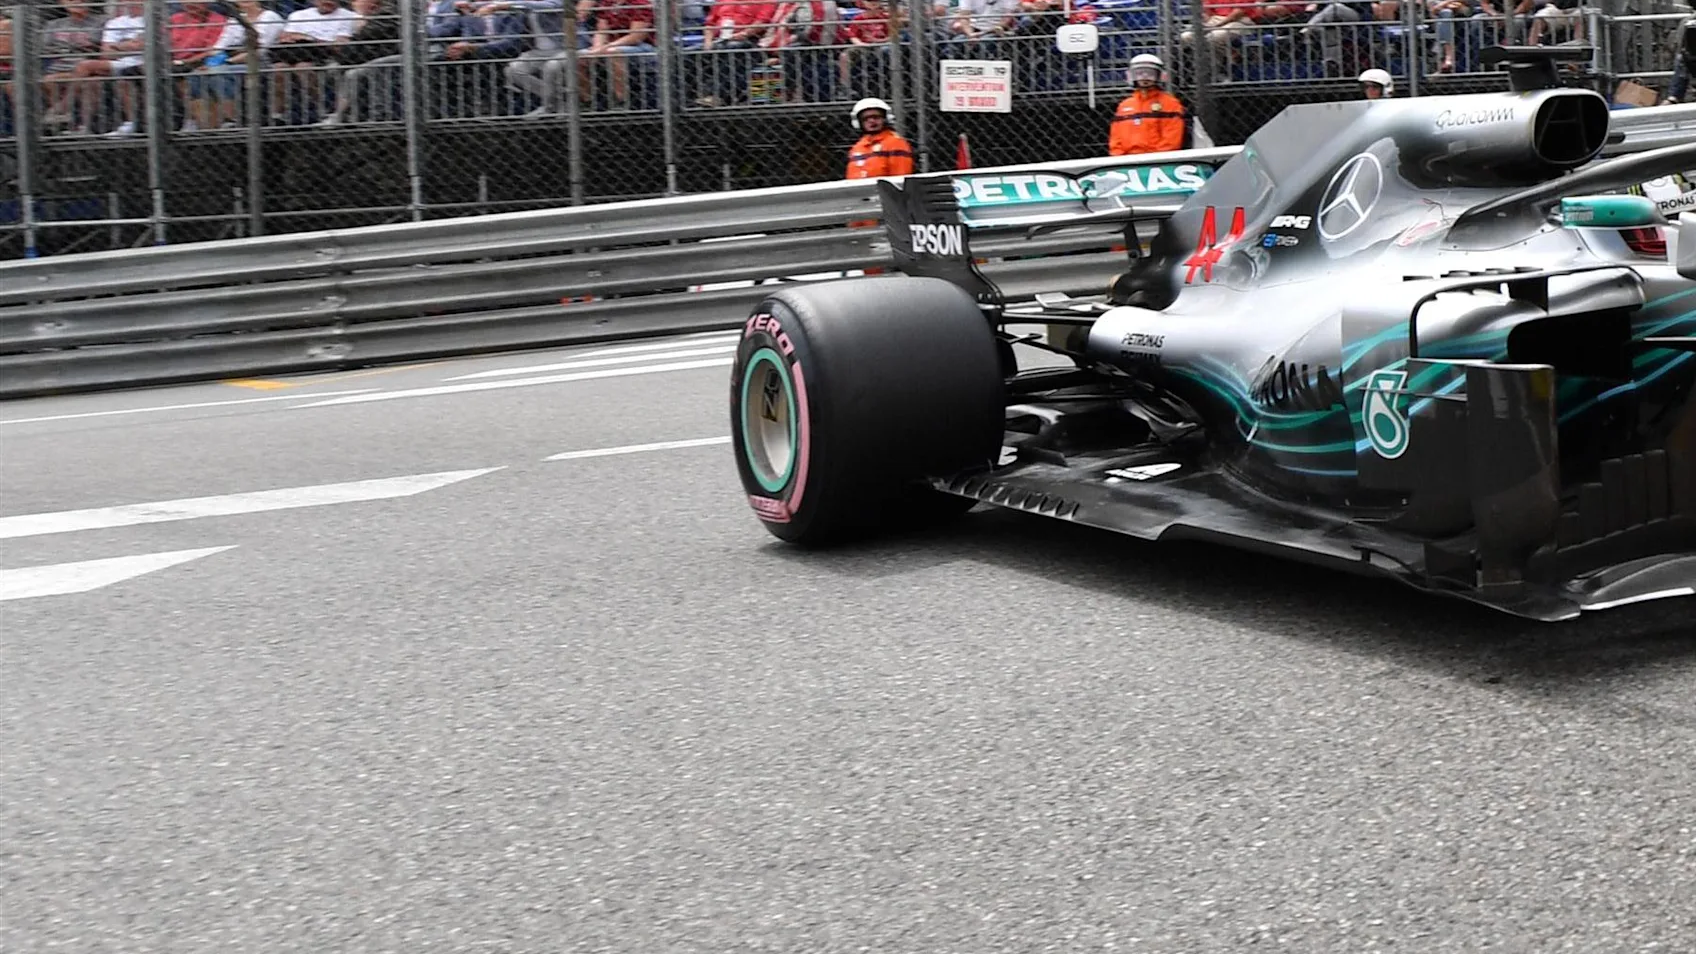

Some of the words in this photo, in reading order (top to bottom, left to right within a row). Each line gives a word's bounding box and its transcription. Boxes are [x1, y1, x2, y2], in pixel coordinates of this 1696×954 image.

[908, 223, 964, 256] EPSON
[745, 313, 795, 356] ZERO
[1121, 332, 1166, 349] PETRONAS
